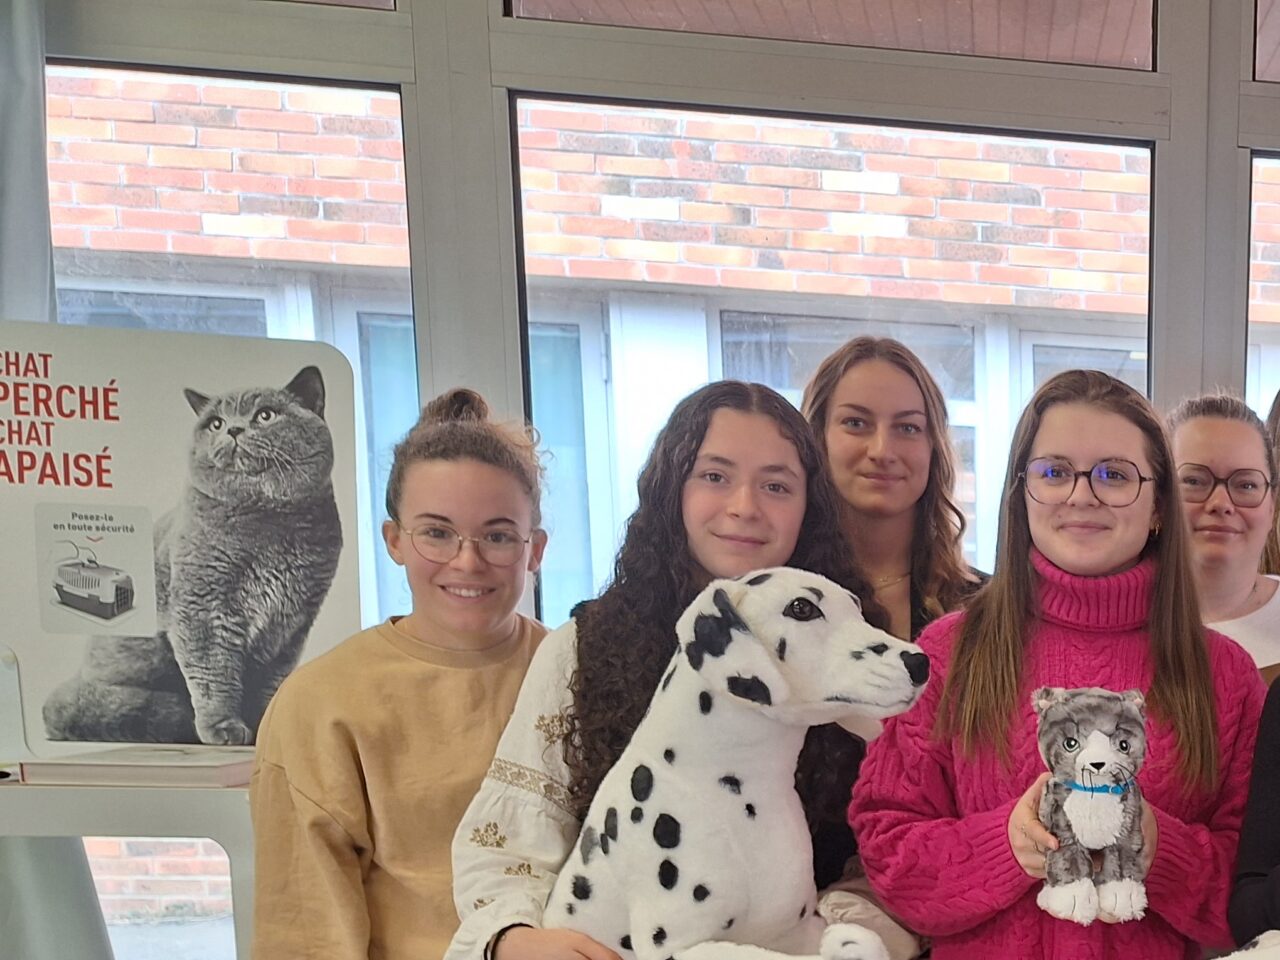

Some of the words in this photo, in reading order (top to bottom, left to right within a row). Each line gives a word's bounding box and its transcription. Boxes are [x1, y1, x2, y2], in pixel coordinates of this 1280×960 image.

[0, 351, 52, 378] HAT
[0, 446, 113, 488] APAISÉ
[71, 512, 114, 521] Posez-le
[67, 523, 92, 531] toute
[95, 524, 135, 533] sécurité
